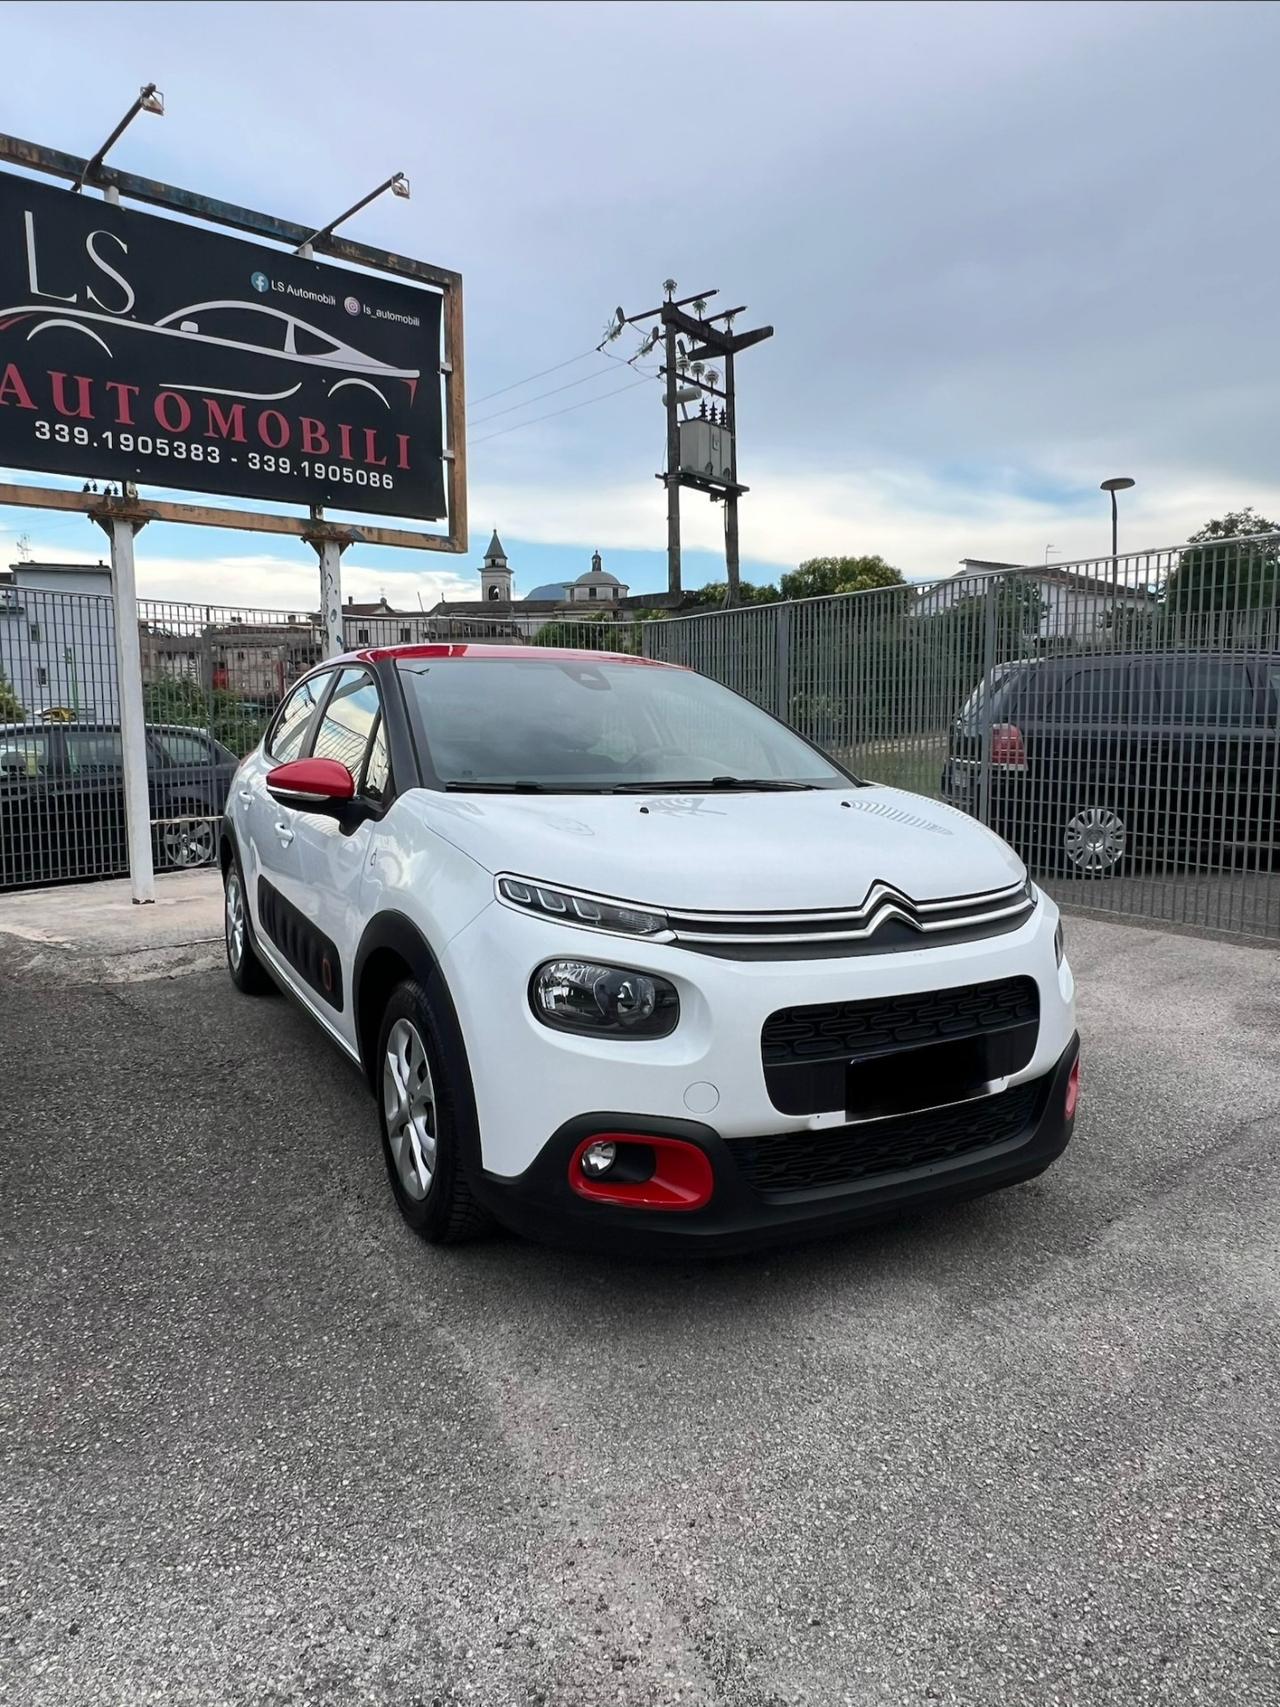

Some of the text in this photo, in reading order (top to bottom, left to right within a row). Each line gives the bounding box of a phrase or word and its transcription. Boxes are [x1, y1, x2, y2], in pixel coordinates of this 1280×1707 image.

[24, 210, 135, 314] LS
[271, 279, 336, 306] LS Automobili
[0, 363, 411, 470] AUTOMOBILI
[35, 420, 221, 464] 339.1905383
[248, 452, 394, 490] 339.1905086
